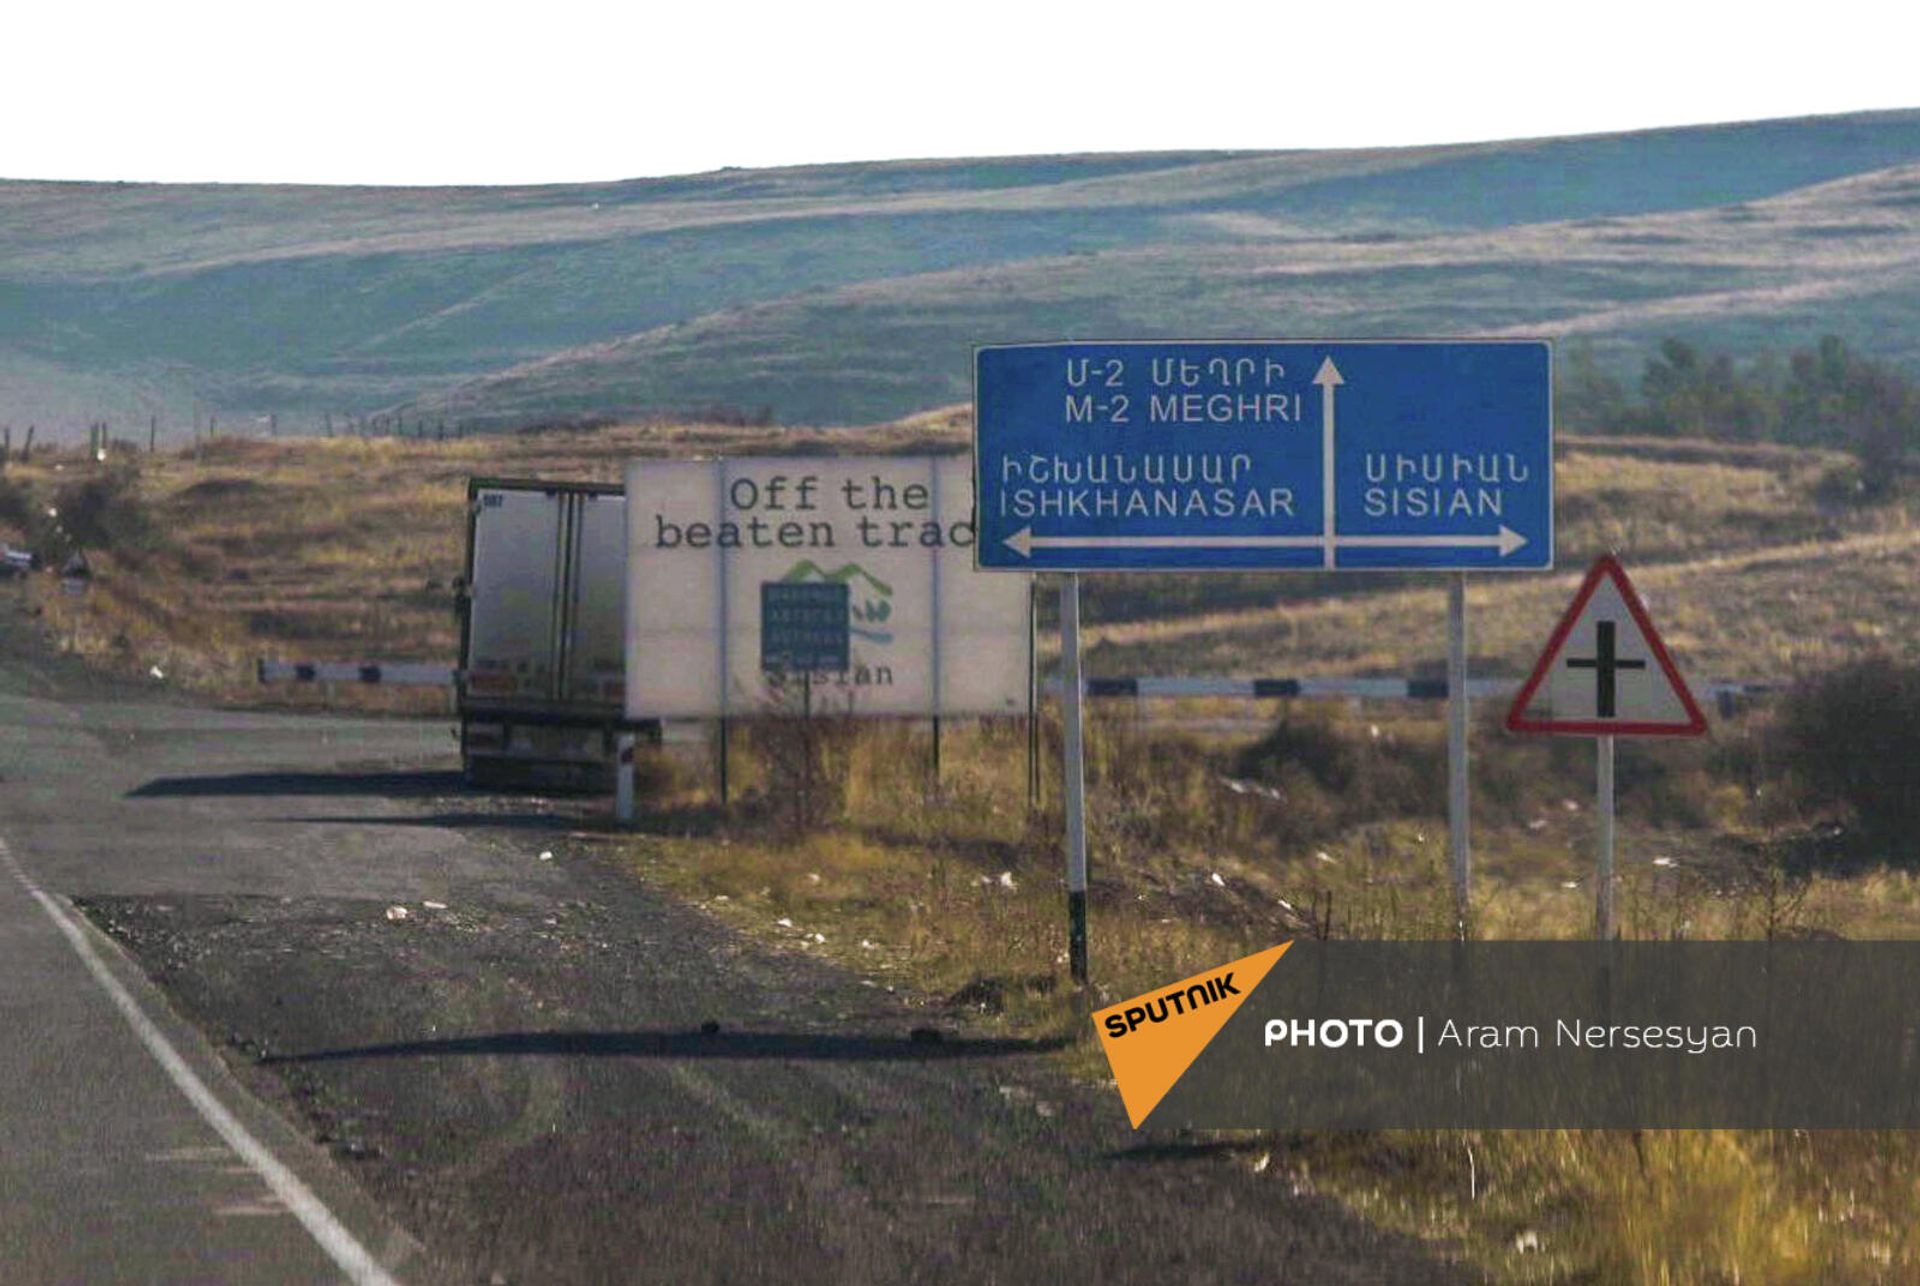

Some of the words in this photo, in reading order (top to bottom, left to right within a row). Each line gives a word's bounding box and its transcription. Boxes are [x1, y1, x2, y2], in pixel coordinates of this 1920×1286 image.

[1067, 358, 1124, 387] Մ-2
[1152, 357, 1285, 387] ՄԵՂՐԻ
[1065, 394, 1130, 422] M-2
[1150, 394, 1301, 422] MEGHRI
[1003, 453, 1252, 483] ԻՇԽԱՆԱՍԱՐ
[1365, 453, 1530, 482] ՍԻՍԻԱՆ
[730, 475, 819, 511] Off
[841, 475, 930, 511] the
[1001, 489, 1294, 517] ISHKHANASAR
[1364, 488, 1503, 517] SISIAN
[655, 514, 836, 548] beaten
[857, 515, 975, 548] trac
